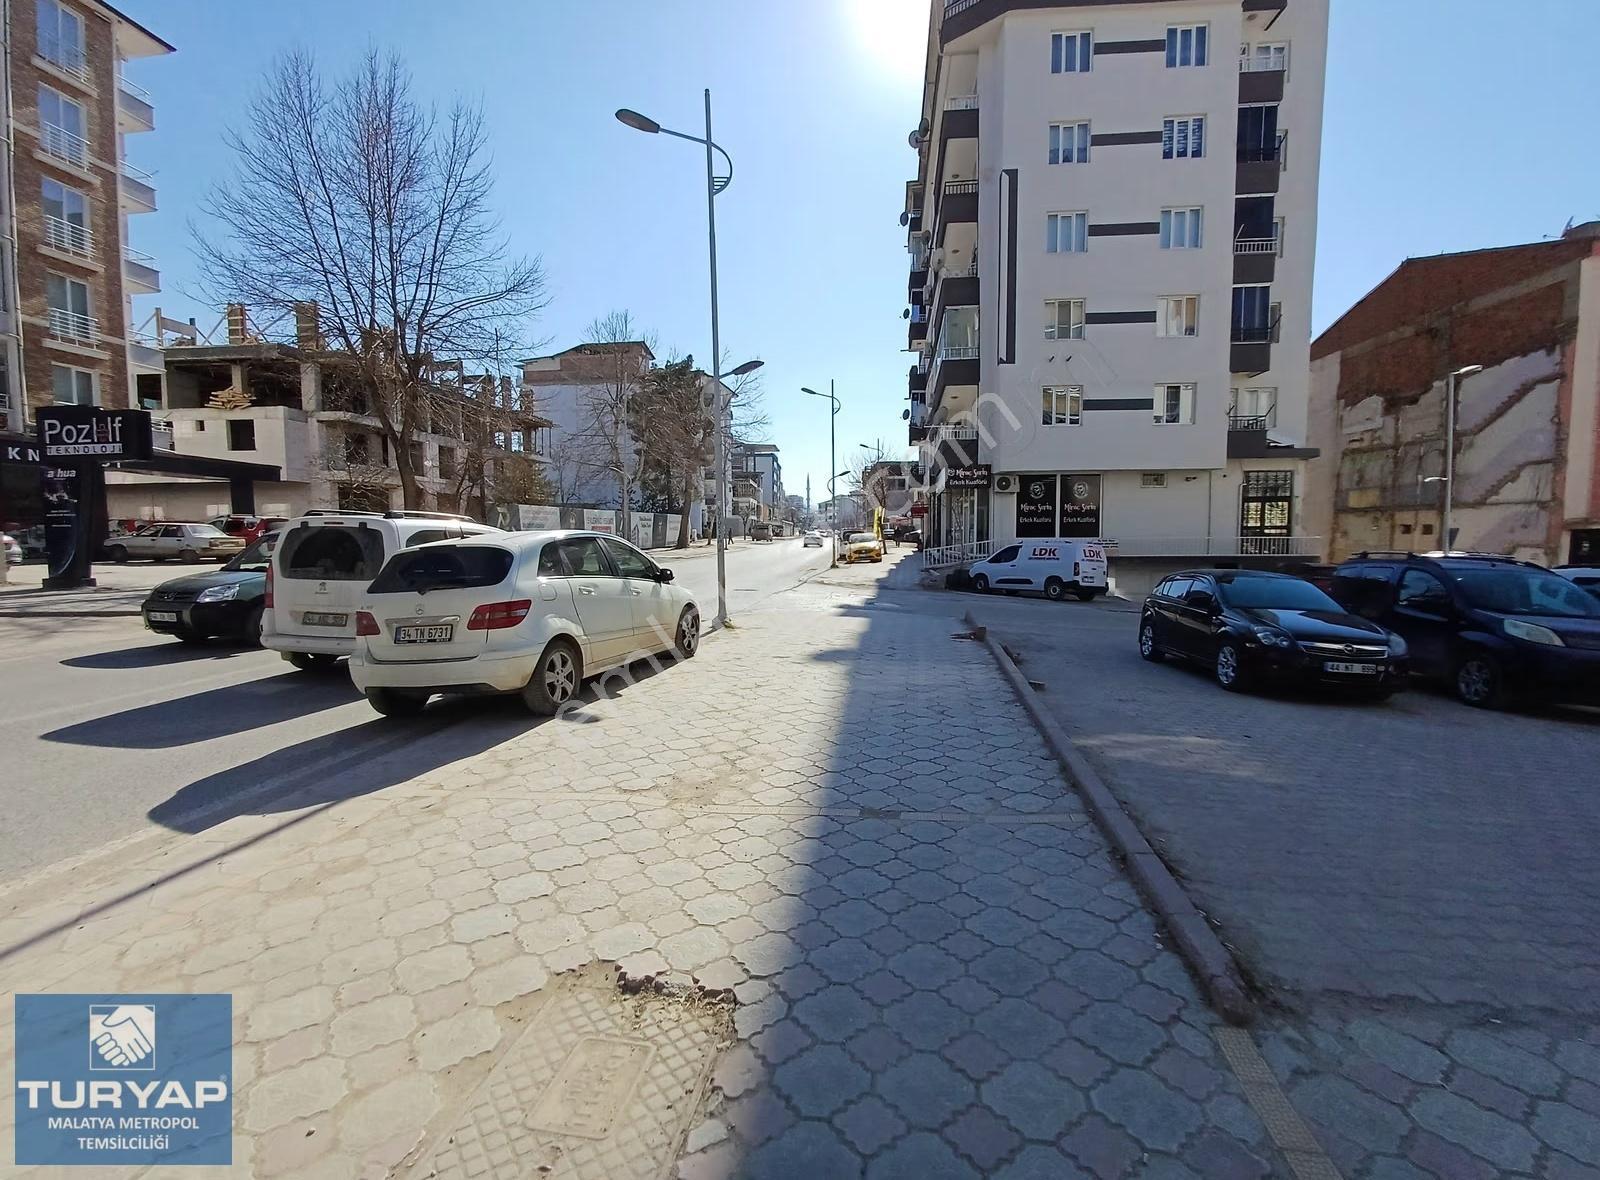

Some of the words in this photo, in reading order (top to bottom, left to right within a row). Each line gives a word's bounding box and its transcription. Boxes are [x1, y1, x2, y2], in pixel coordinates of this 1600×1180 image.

[1032, 547, 1058, 557] LDK
[1083, 549, 1103, 559] LDK
[401, 629, 411, 640] 34
[414, 627, 425, 639] TN
[427, 626, 449, 639] 6731
